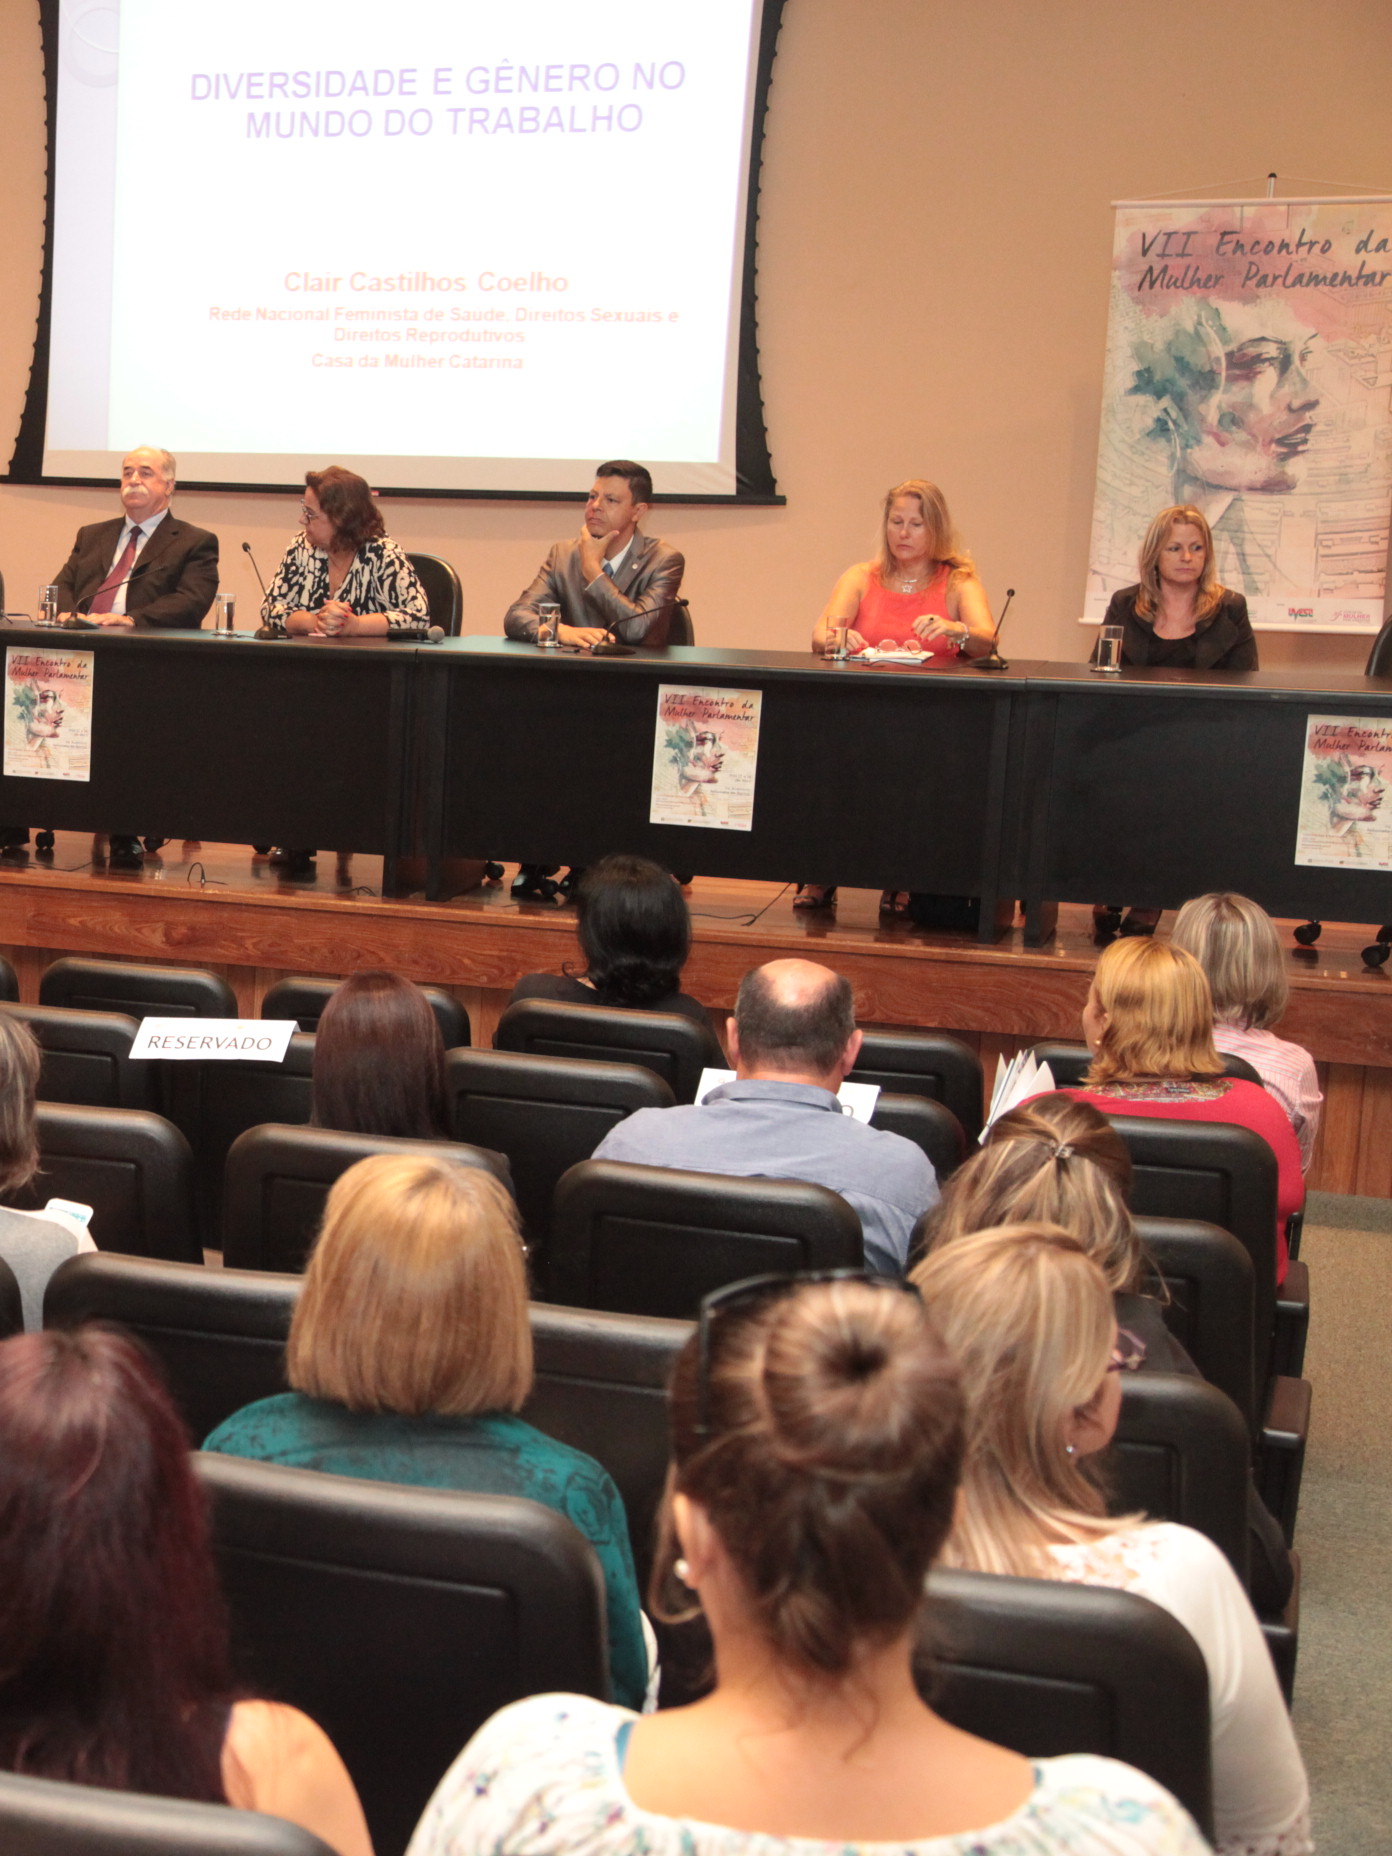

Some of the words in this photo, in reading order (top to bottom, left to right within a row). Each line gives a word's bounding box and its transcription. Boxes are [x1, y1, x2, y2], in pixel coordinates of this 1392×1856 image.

[190, 68, 417, 100] DIVERSIDADE
[433, 66, 453, 95] E
[465, 58, 620, 94] GÊNERO
[632, 60, 686, 90] NO
[245, 109, 373, 139] MUNDO
[384, 108, 433, 137] DO
[447, 103, 643, 136] TRABALHO
[1141, 230, 1198, 259] VII
[1216, 228, 1332, 257] Encontro
[1355, 229, 1391, 256] da
[284, 271, 342, 292] Clair
[349, 271, 467, 292] Castilhos
[478, 271, 569, 292] Coelho
[1137, 265, 1224, 292] Mulher
[1241, 260, 1392, 289] Parlamentar
[209, 306, 252, 321] Rede
[256, 306, 330, 321] Nacional
[334, 306, 419, 321] Feminista
[423, 306, 445, 321] de
[515, 306, 586, 322] Direitos
[591, 306, 663, 322] Sexuais
[668, 310, 681, 322] e
[334, 327, 402, 342] Direitos
[406, 327, 526, 344] Reprodutivos
[311, 353, 354, 368] Casa
[358, 353, 382, 368] da
[384, 353, 444, 369] Mulher
[449, 353, 524, 369] Catarina
[693, 696, 734, 708] Encontro
[664, 706, 696, 718] Mulher
[702, 708, 755, 722] Parlamentar
[1315, 724, 1340, 736] VII
[1347, 726, 1392, 739] Encontr
[1314, 738, 1351, 750] Mulher
[147, 1034, 272, 1051] RESERVADO
